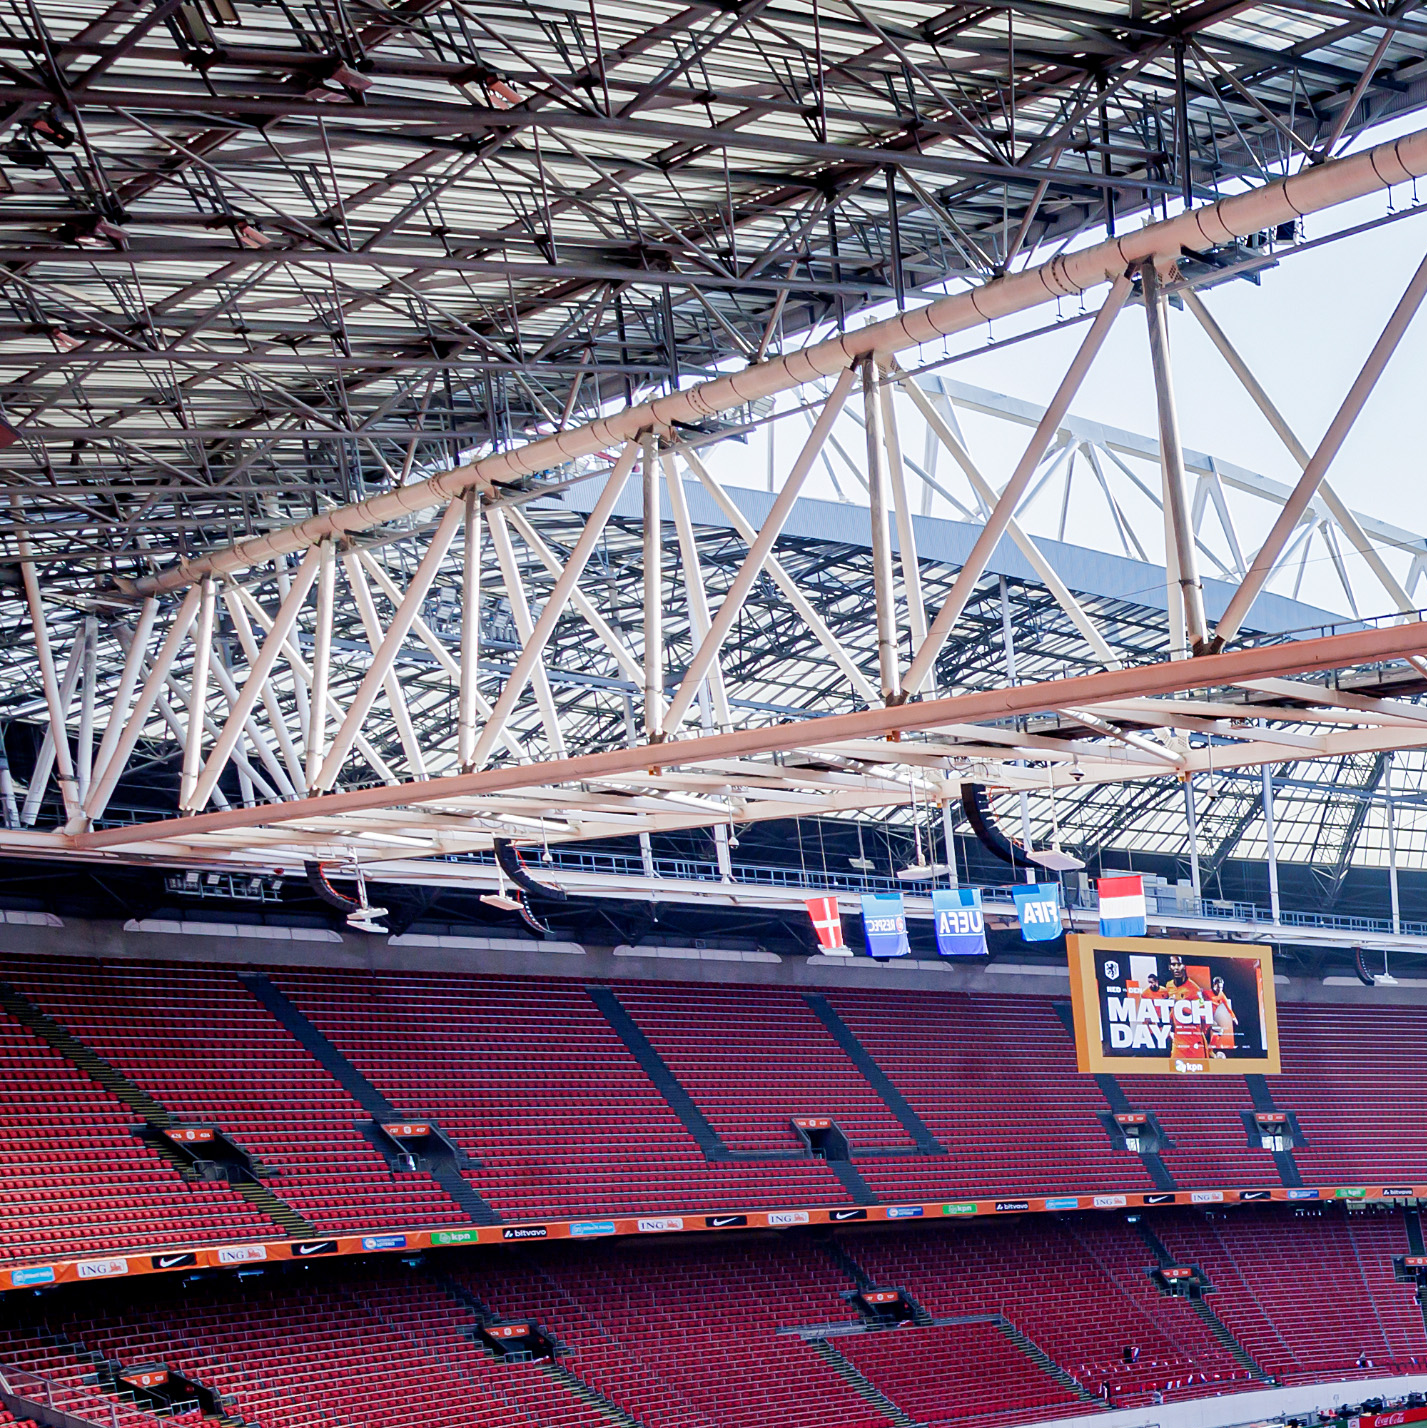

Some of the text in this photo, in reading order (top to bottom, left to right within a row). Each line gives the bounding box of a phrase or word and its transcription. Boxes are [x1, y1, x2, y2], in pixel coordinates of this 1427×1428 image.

[1107, 996, 1214, 1024] MATCH
[1110, 1024, 1172, 1049] DAY
[1185, 1061, 1203, 1073] kpn
[1004, 1202, 1028, 1210] bitvavo
[1095, 1198, 1113, 1206] ING
[957, 1204, 972, 1213] kpn
[771, 1215, 792, 1223] ING
[641, 1222, 664, 1230] ING
[451, 1231, 471, 1242] kpn
[514, 1228, 547, 1237] bitvavo
[221, 1250, 245, 1261] ING
[81, 1264, 106, 1276] ING
